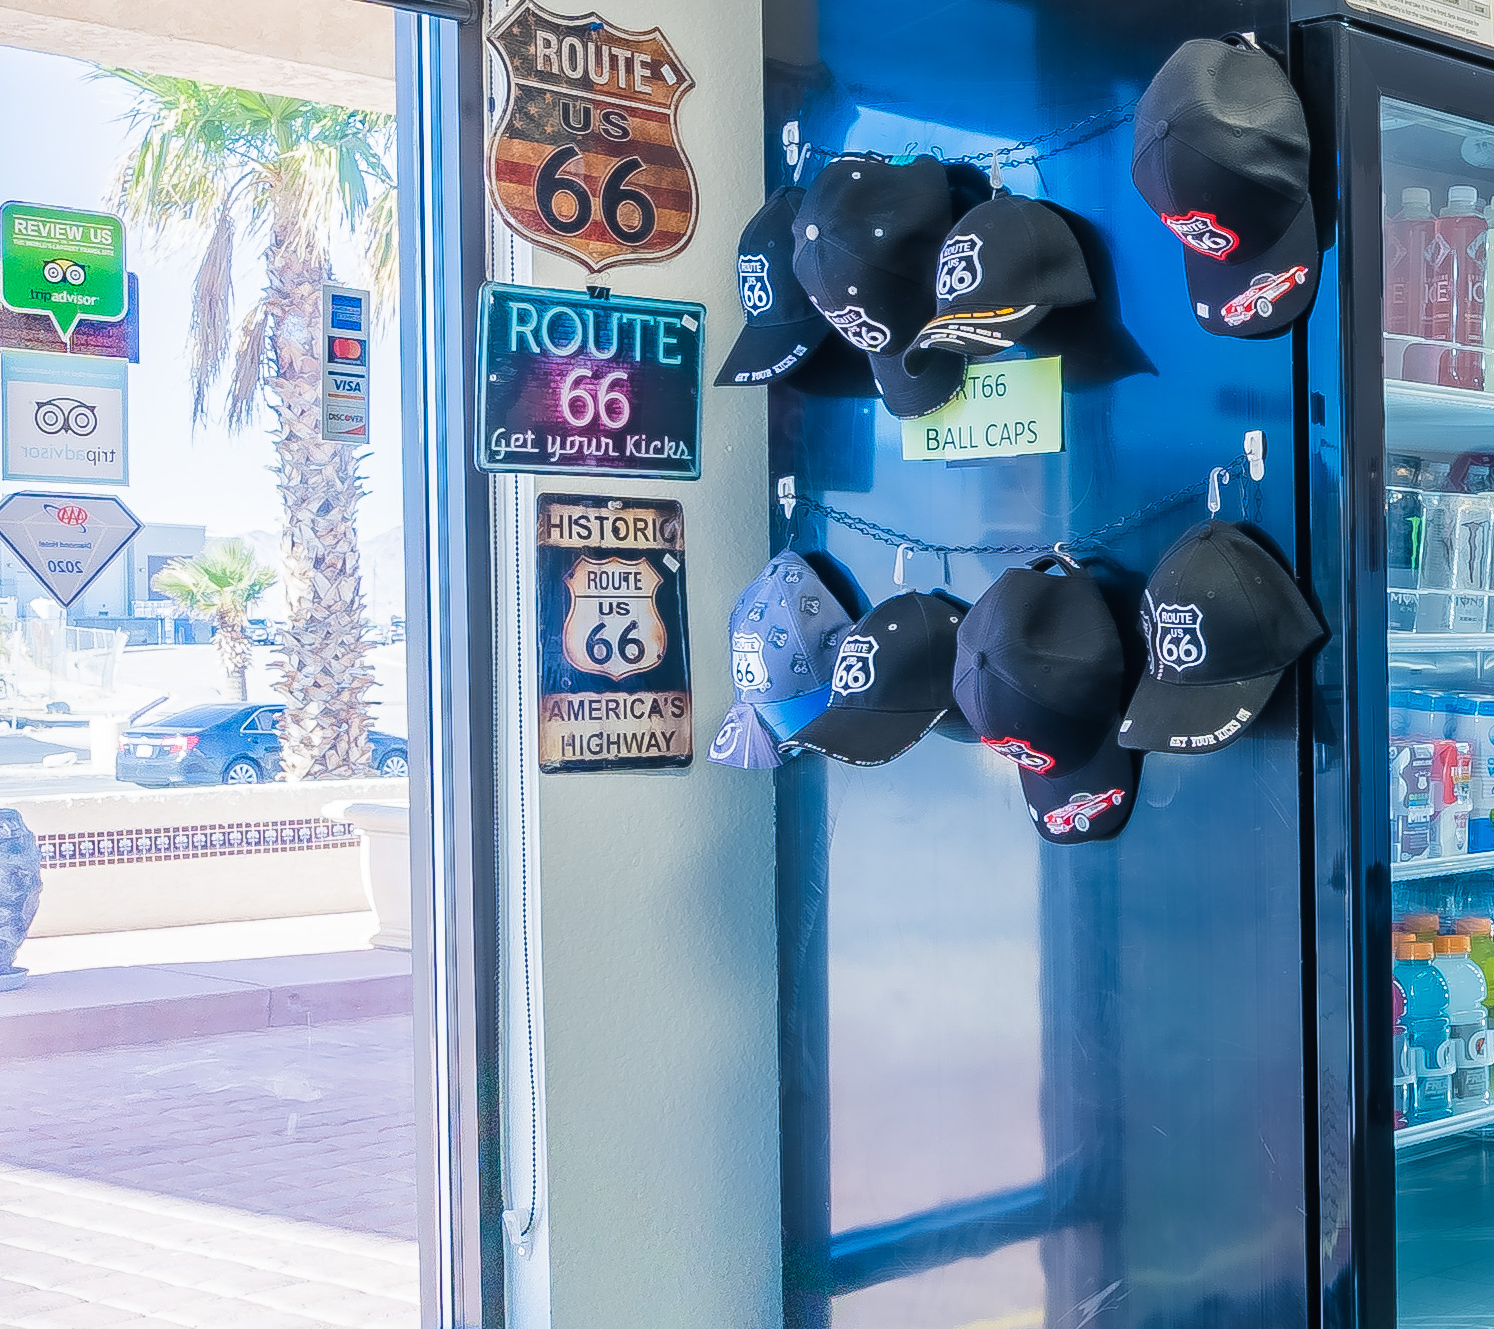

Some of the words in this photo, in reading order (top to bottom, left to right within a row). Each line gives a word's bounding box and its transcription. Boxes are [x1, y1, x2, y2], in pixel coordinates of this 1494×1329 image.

[535, 29, 654, 94] ROUTE
[559, 100, 632, 142] US
[534, 143, 658, 247] 66
[14, 218, 84, 241] REVIEW
[89, 227, 113, 245] US
[943, 241, 972, 257] ROUTE
[948, 258, 960, 269] US
[937, 260, 973, 295] 66
[28, 288, 98, 306] tripadvisor
[743, 281, 768, 307] 66
[508, 301, 683, 366] ROUTE
[332, 379, 362, 393] VISA
[560, 369, 632, 430] 66
[328, 412, 364, 423] DISCOVER
[490, 427, 540, 460] Get
[547, 432, 620, 464] your
[624, 433, 694, 460] Kicks
[924, 426, 980, 452] BALL
[986, 420, 1039, 449] CAPS
[545, 513, 676, 545] HISTORIC
[586, 570, 643, 593] ROUTE
[598, 601, 631, 616] US
[1161, 612, 1193, 624] ROUTE
[584, 619, 646, 666] 66
[1171, 628, 1185, 638] US
[843, 643, 871, 654] ROUTE
[1162, 633, 1198, 662] 66
[736, 661, 756, 684] 66
[835, 660, 866, 689] 66
[546, 695, 686, 723] AMERICA'S
[560, 729, 677, 756] HIGHWAY
[1191, 734, 1218, 748] YOUR
